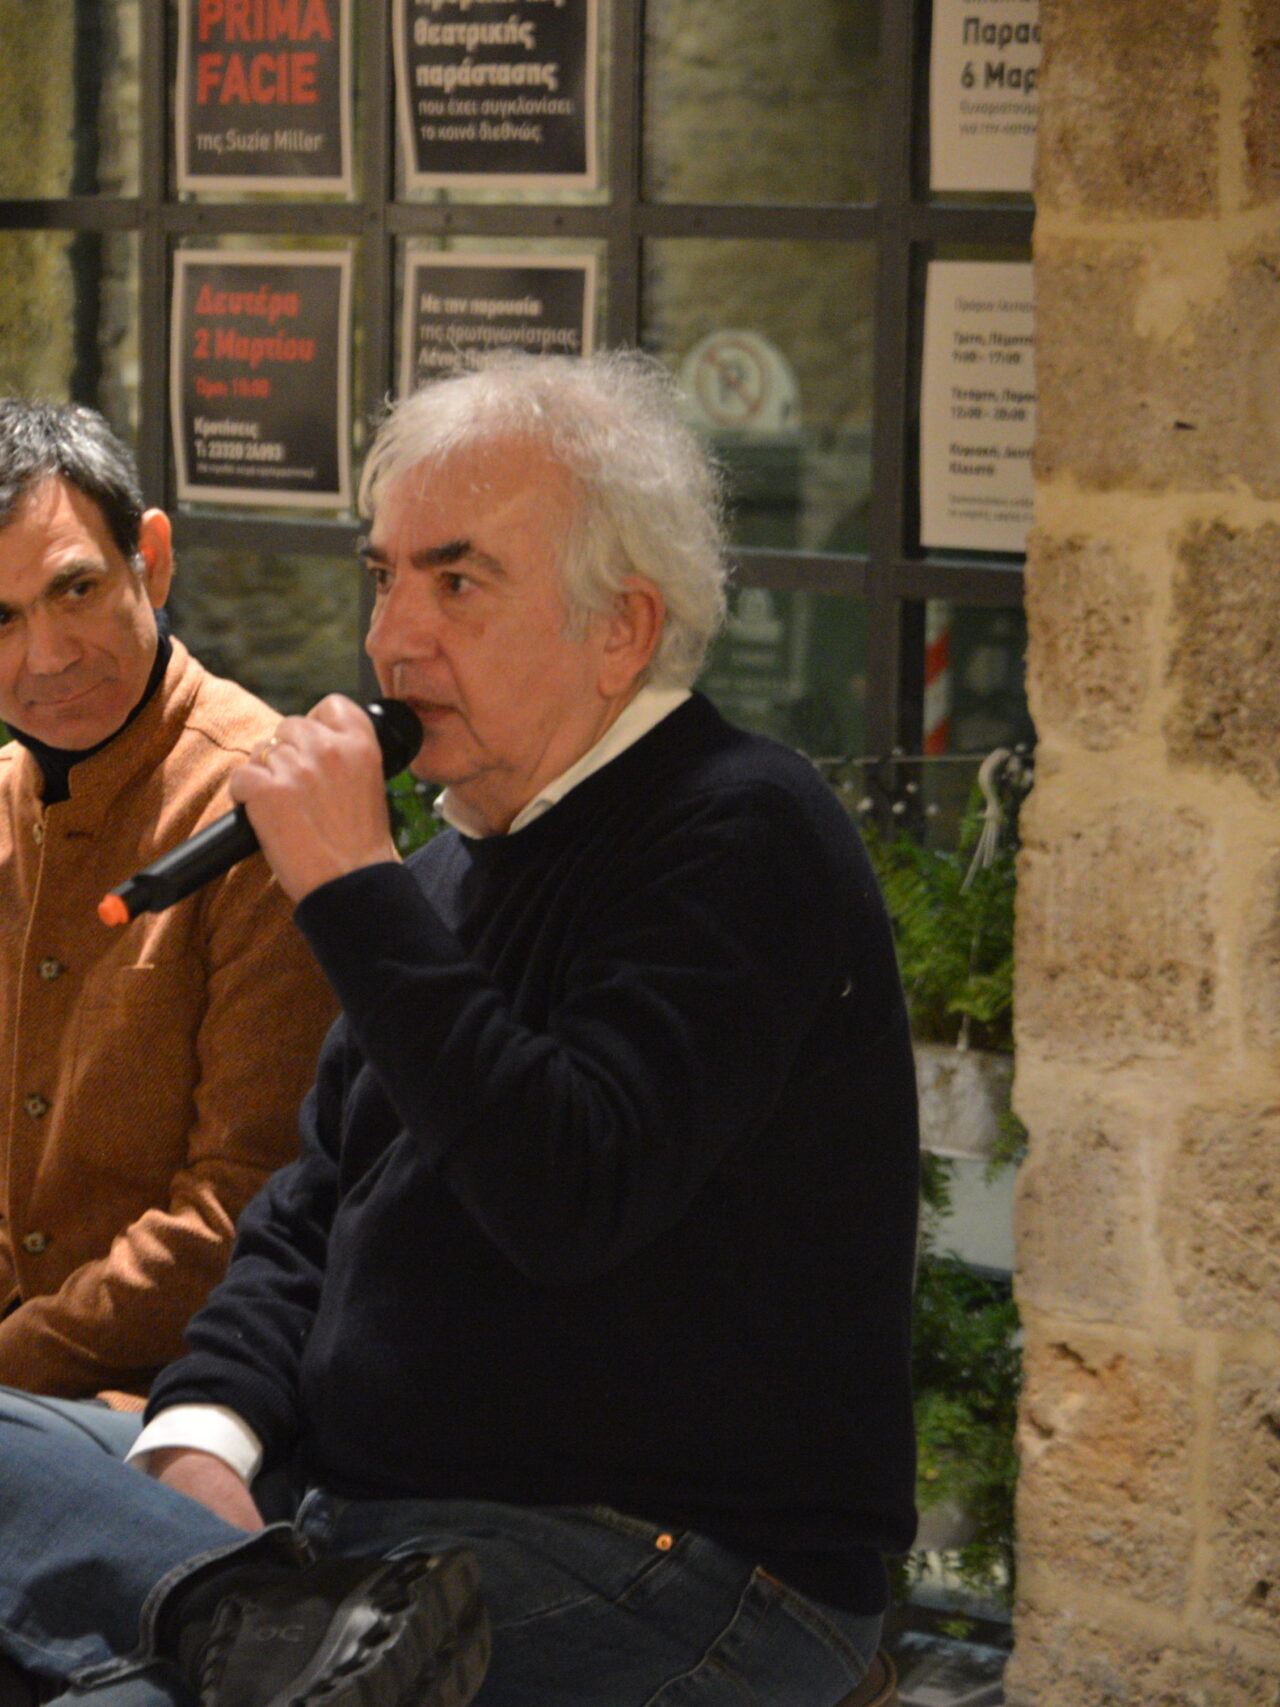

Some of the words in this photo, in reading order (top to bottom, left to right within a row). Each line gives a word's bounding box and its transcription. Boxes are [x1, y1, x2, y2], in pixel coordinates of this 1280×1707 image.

[198, 0, 332, 42] PRIMA
[414, 15, 537, 52] θεατρικής
[197, 52, 319, 104] FACIE
[416, 56, 558, 93] παράστασης
[961, 61, 975, 89] 6
[419, 100, 444, 115] που
[447, 97, 477, 115] έχει
[197, 132, 222, 155] της
[225, 128, 270, 152] Suzie
[273, 129, 324, 152] Miller
[422, 124, 436, 140] το
[438, 122, 475, 141] κοινό
[195, 283, 300, 325] Δευτέρα
[194, 328, 211, 359] 2
[215, 328, 316, 370] Μαρτίου
